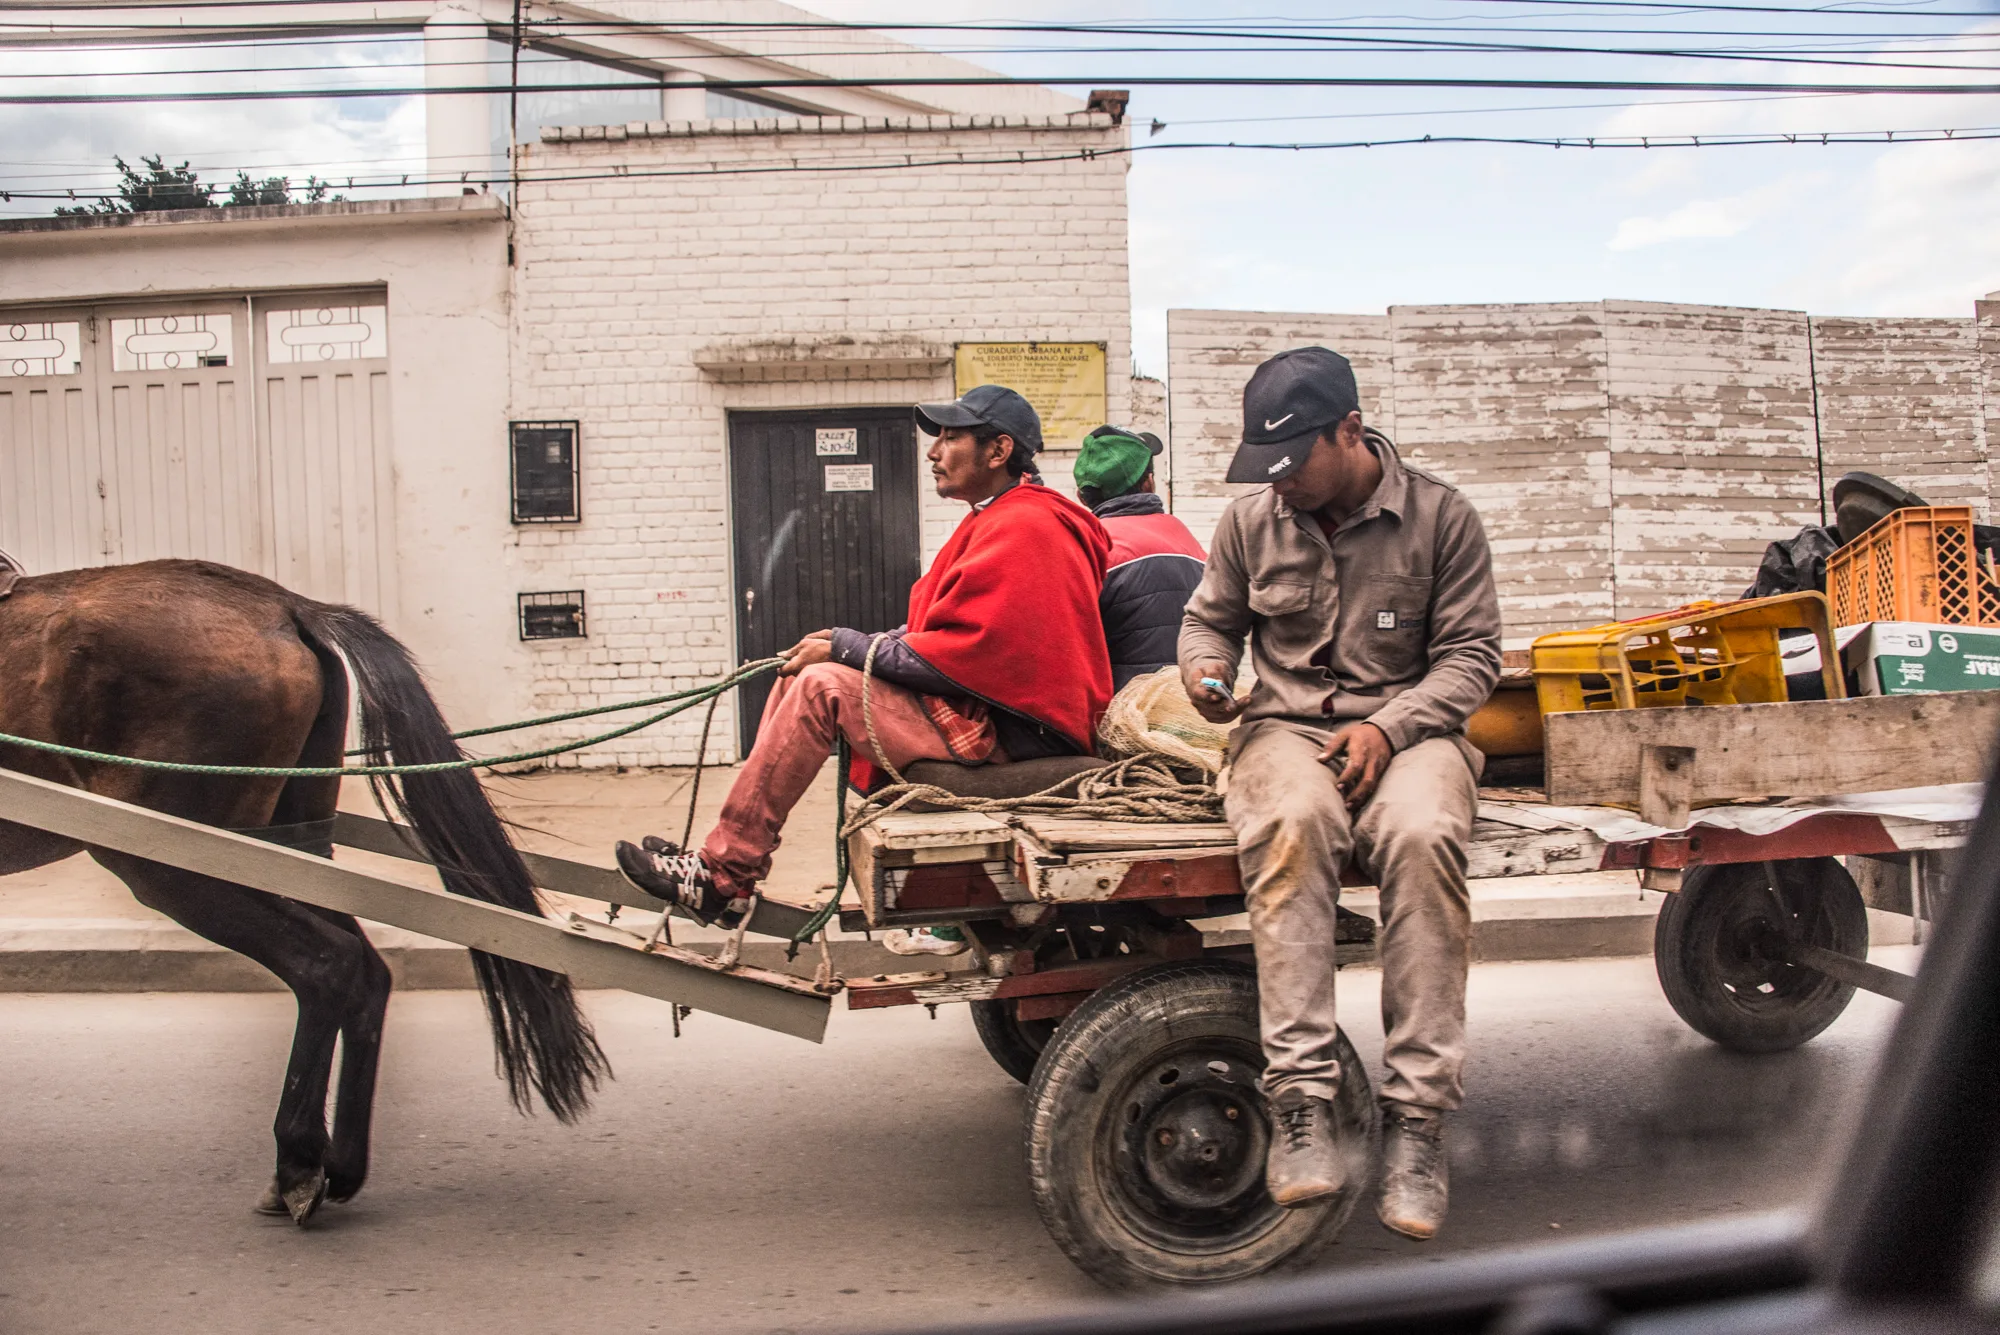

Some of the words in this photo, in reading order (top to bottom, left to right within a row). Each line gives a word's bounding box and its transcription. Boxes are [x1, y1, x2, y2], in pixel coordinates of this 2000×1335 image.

[848, 431, 855, 442] 7
[1267, 456, 1292, 475] NIKE
[1964, 661, 2000, 676] RAF
